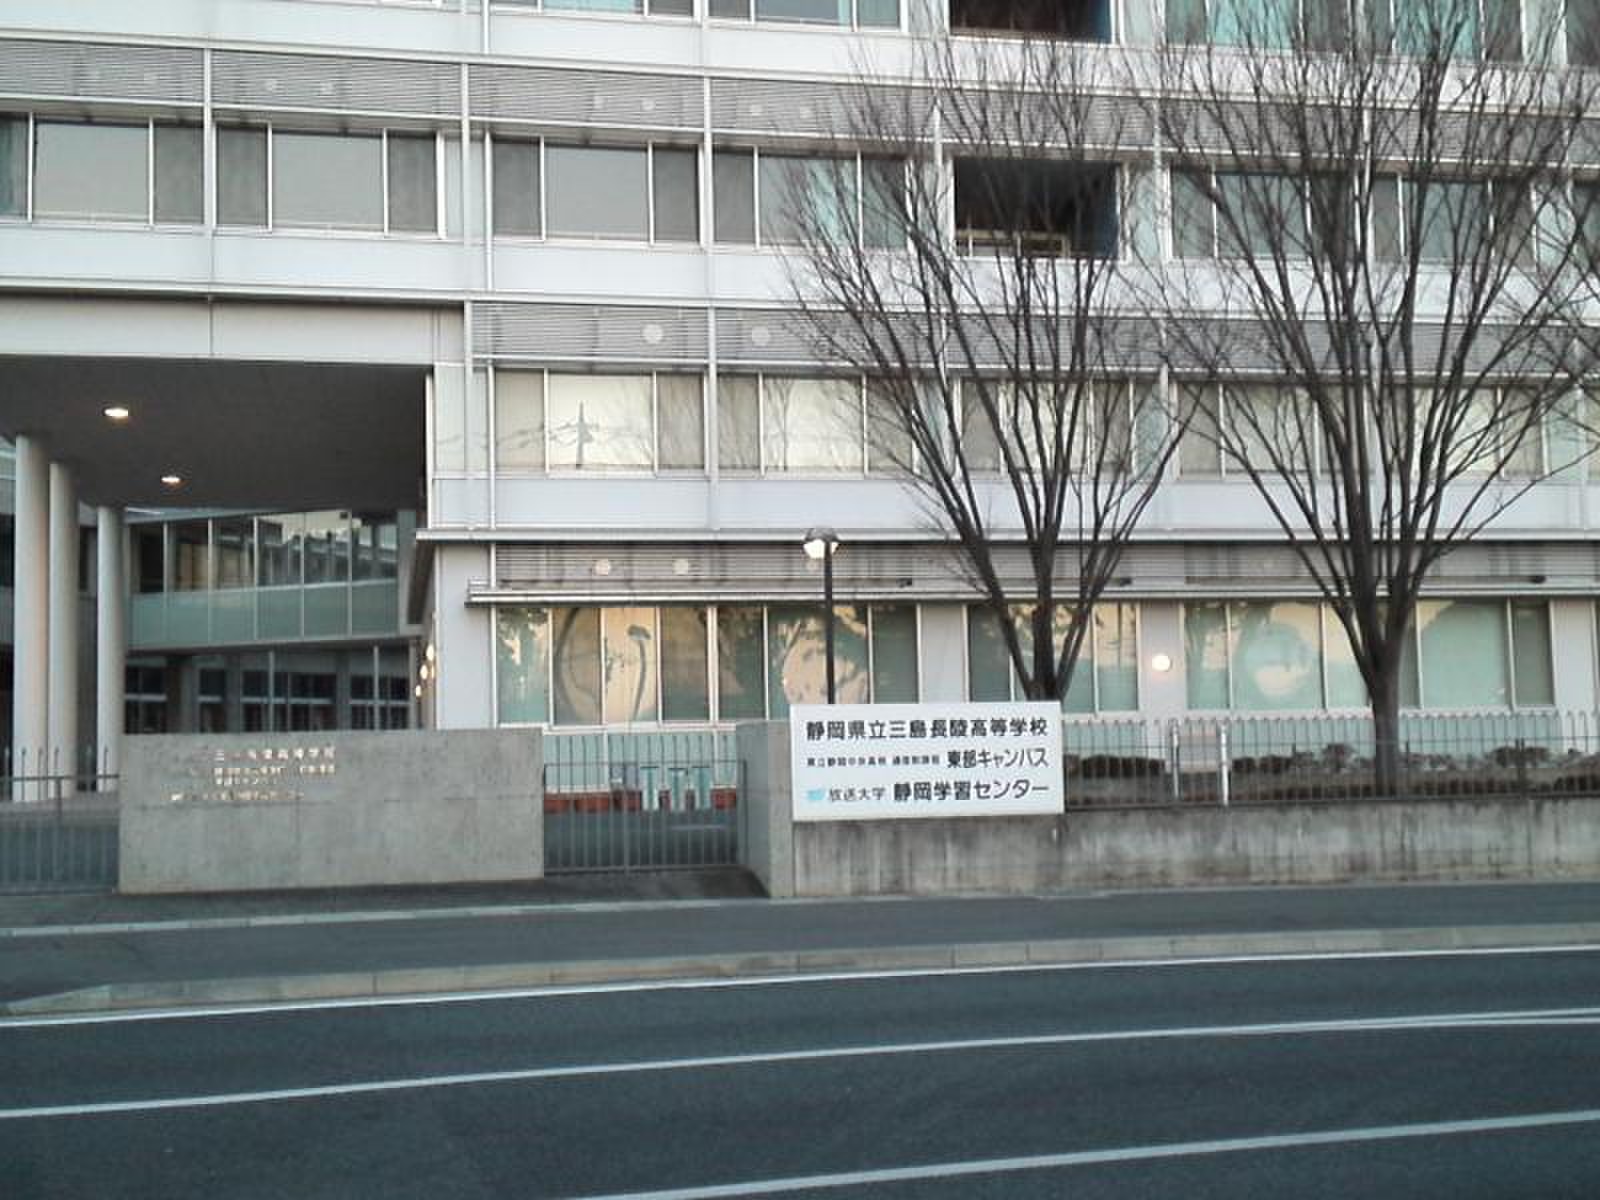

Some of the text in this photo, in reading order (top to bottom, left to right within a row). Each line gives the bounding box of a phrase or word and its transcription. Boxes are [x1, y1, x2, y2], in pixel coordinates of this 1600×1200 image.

[806, 718, 1048, 740] 静岡県立三島長陵高等学校
[947, 748, 1049, 769] 東部キャンパス
[893, 779, 1049, 802] 静岡学習センター
